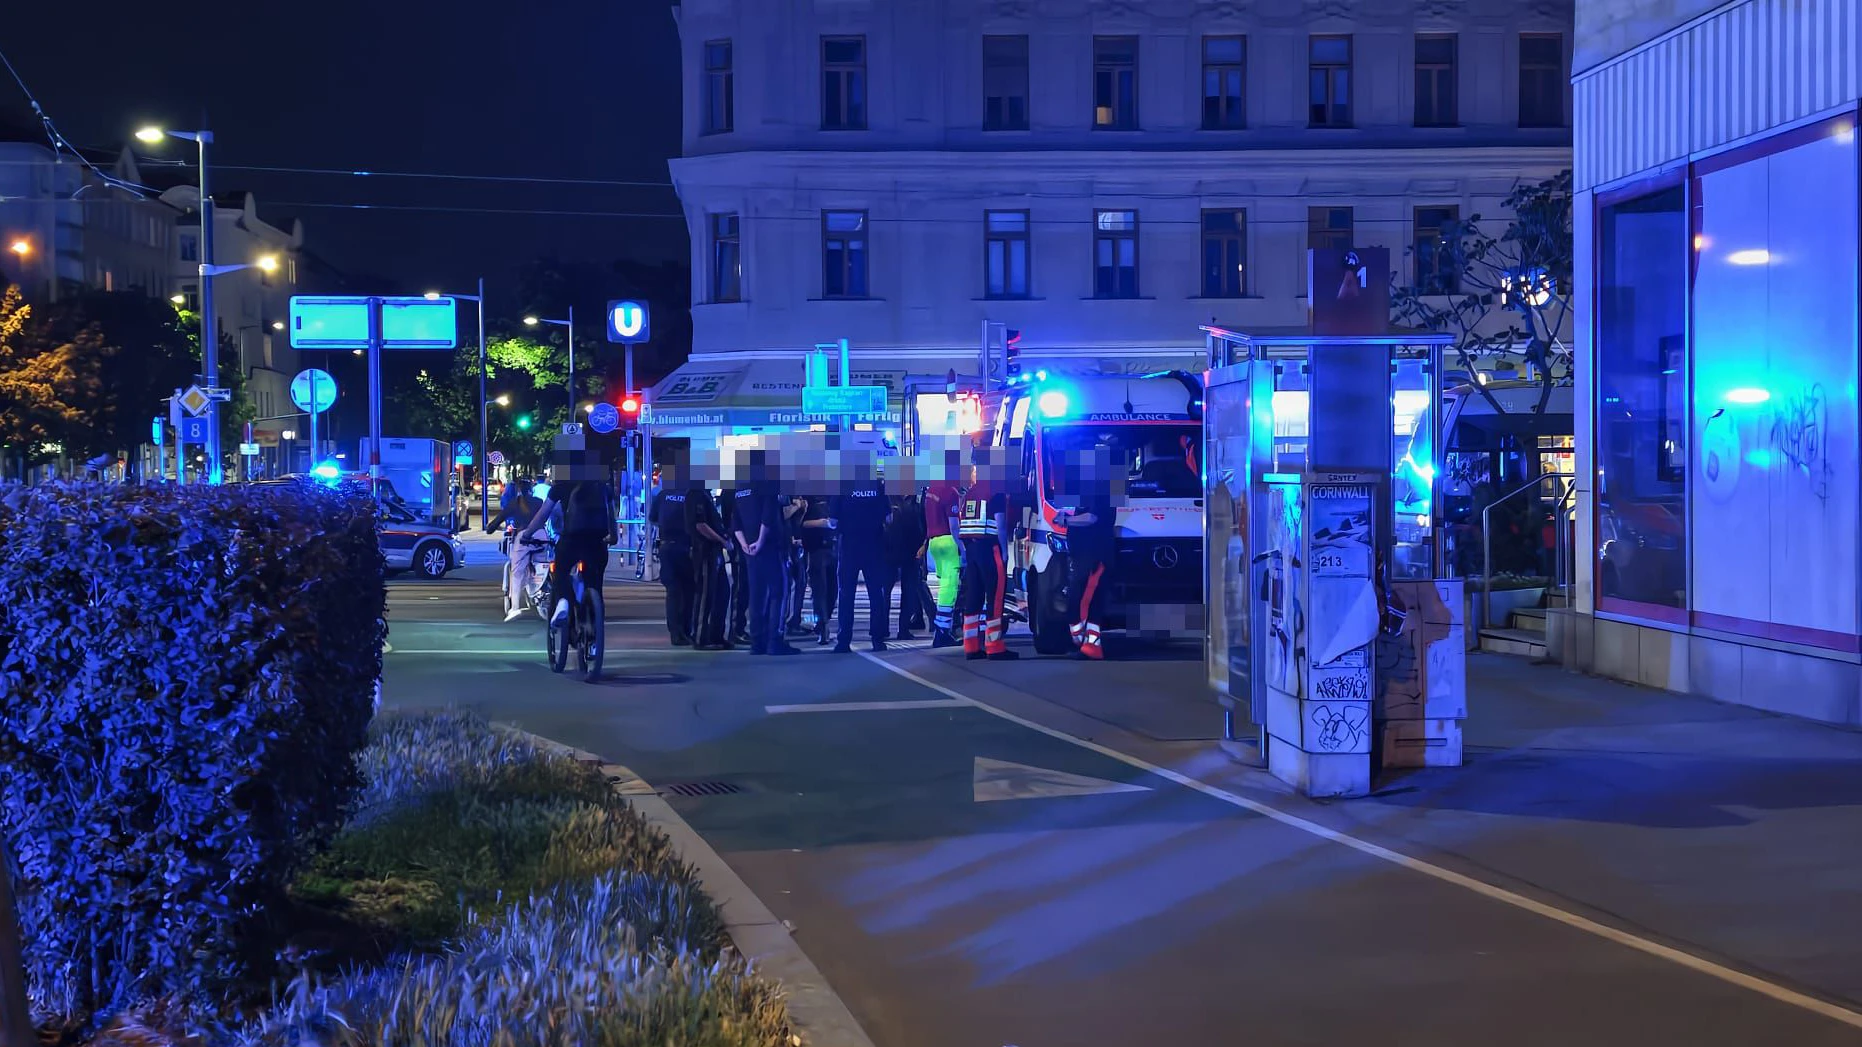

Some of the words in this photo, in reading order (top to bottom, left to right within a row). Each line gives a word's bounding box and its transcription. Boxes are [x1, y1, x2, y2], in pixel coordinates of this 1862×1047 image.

[615, 307, 642, 337] U
[637, 414, 723, 425] .blumenbb.at
[1090, 413, 1172, 422] AMBULANCE
[191, 423, 200, 438] 8
[851, 490, 877, 498] POLIZEI
[1312, 486, 1370, 499] CORNWALL
[1320, 556, 1342, 567] 213
